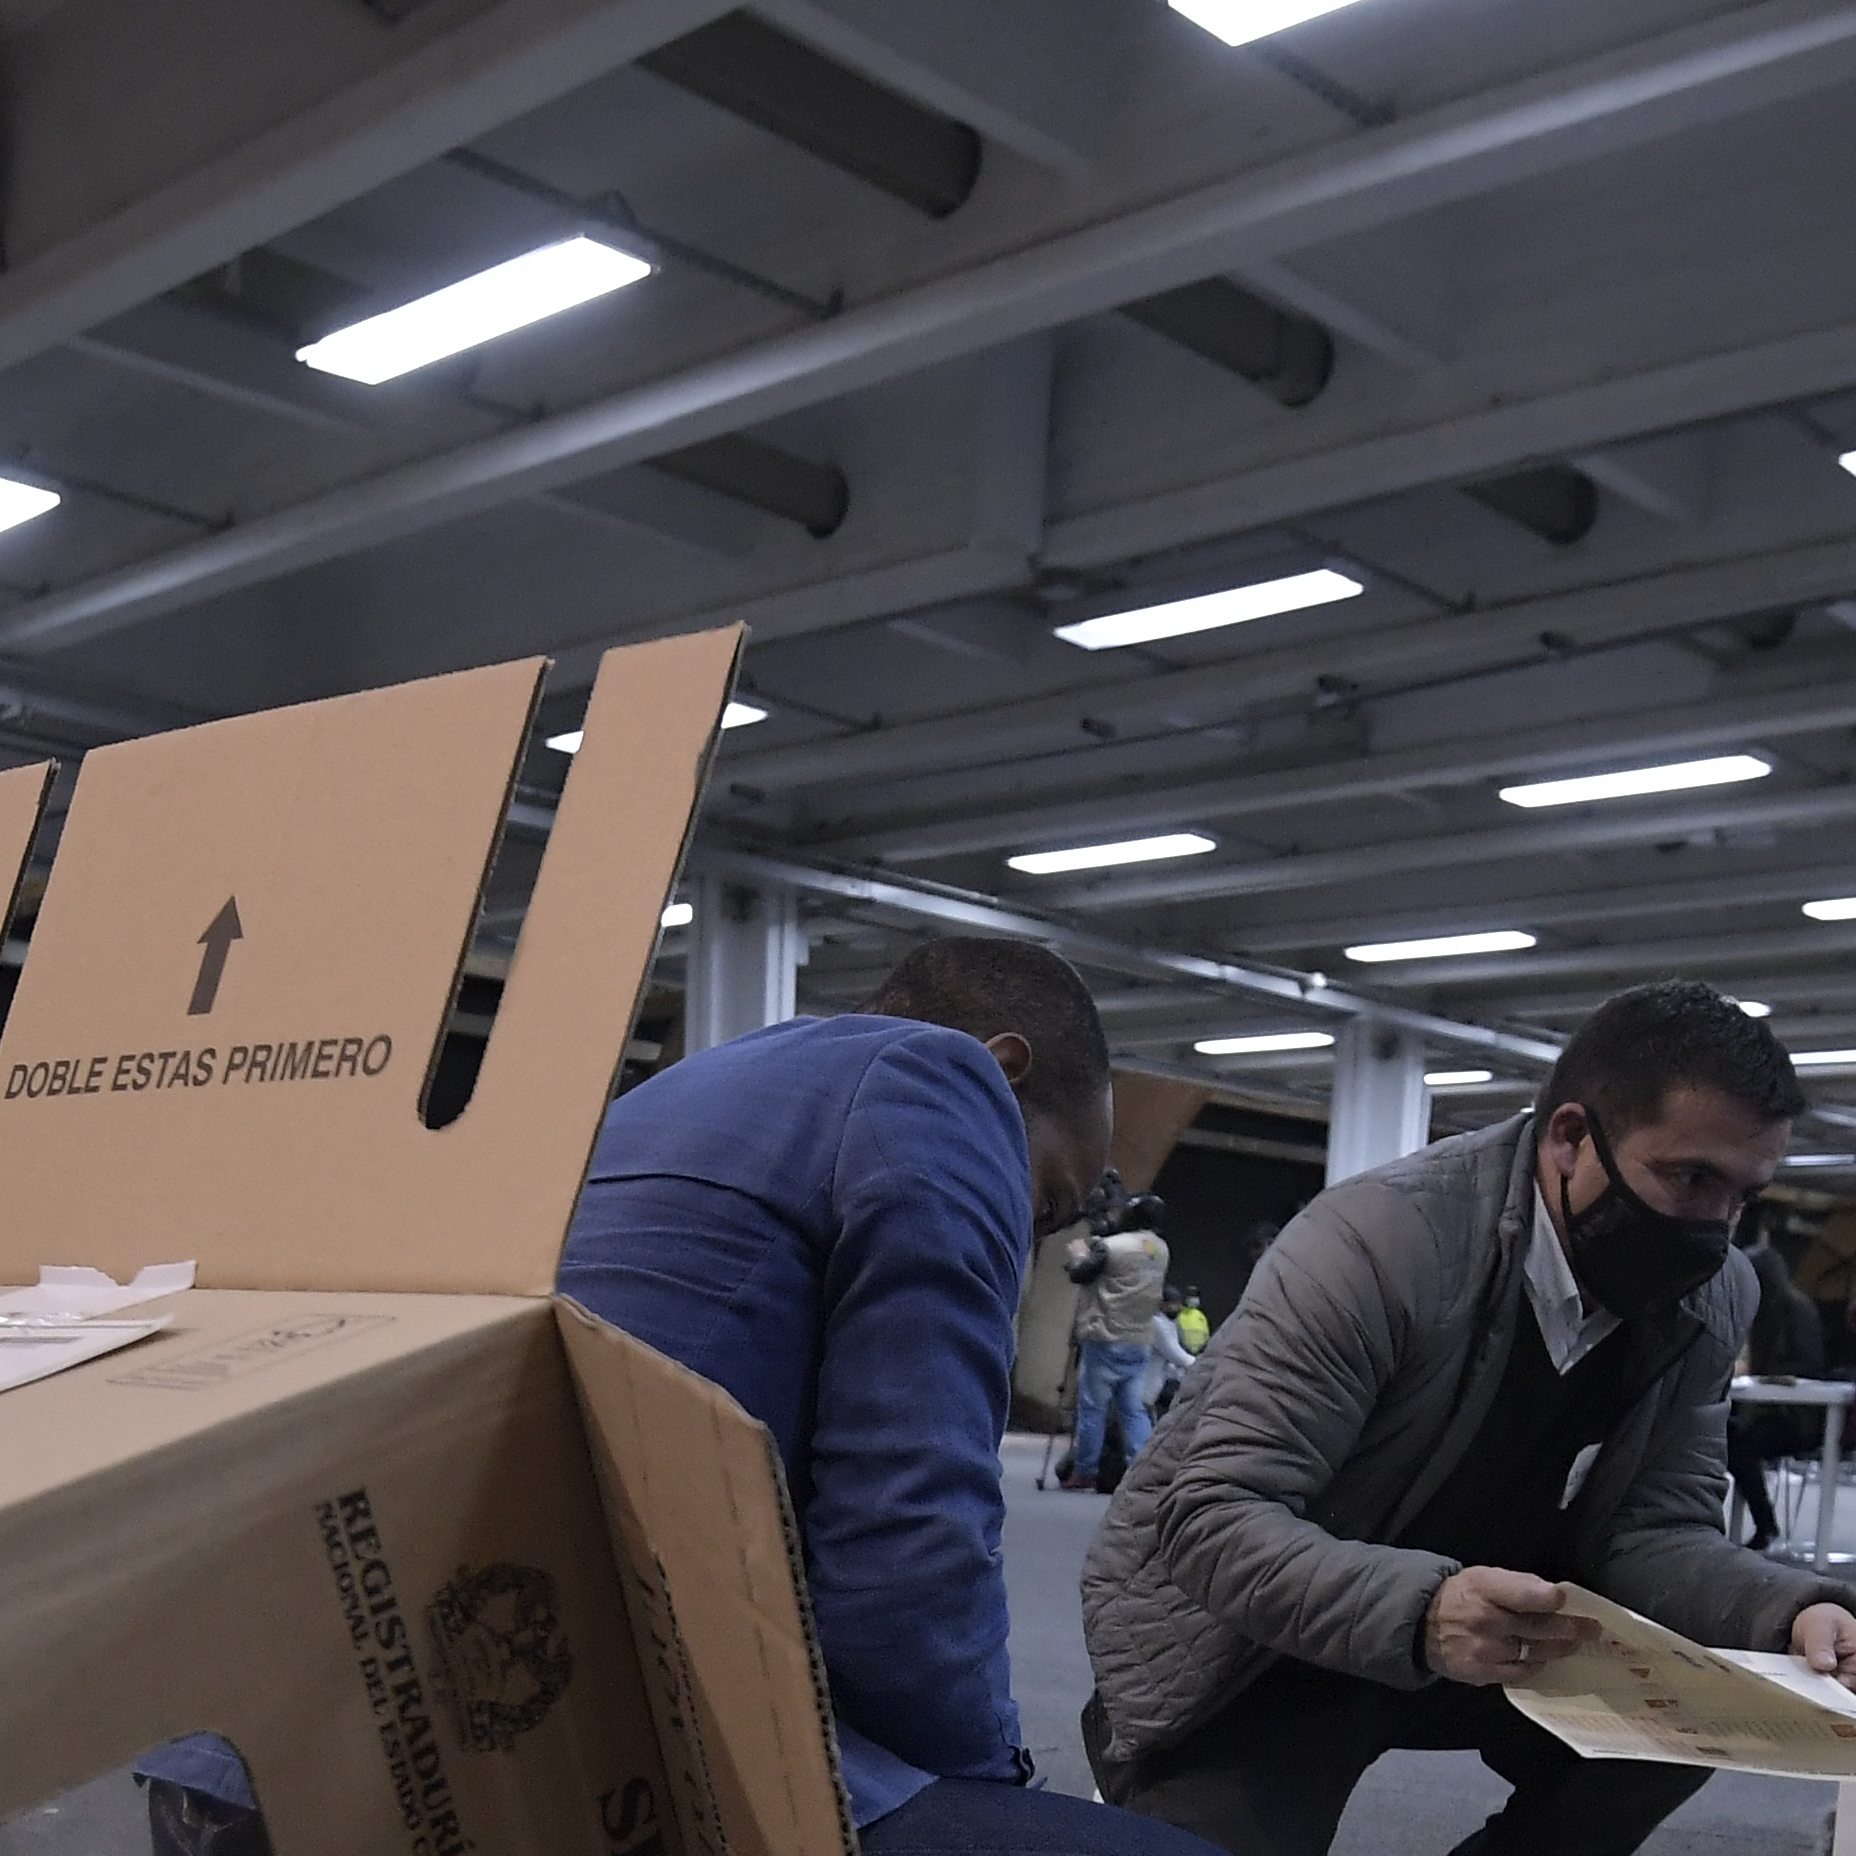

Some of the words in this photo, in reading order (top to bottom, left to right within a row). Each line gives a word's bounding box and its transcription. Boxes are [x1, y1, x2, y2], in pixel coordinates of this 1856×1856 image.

[4, 1056, 107, 1100] DOBLE
[111, 1048, 217, 1092] ESTAS
[222, 1034, 393, 1086] PRIMERO
[314, 1500, 363, 1653] NACIONAL
[359, 1655, 384, 1717] DEL
[379, 1720, 424, 1833] ESTADO
